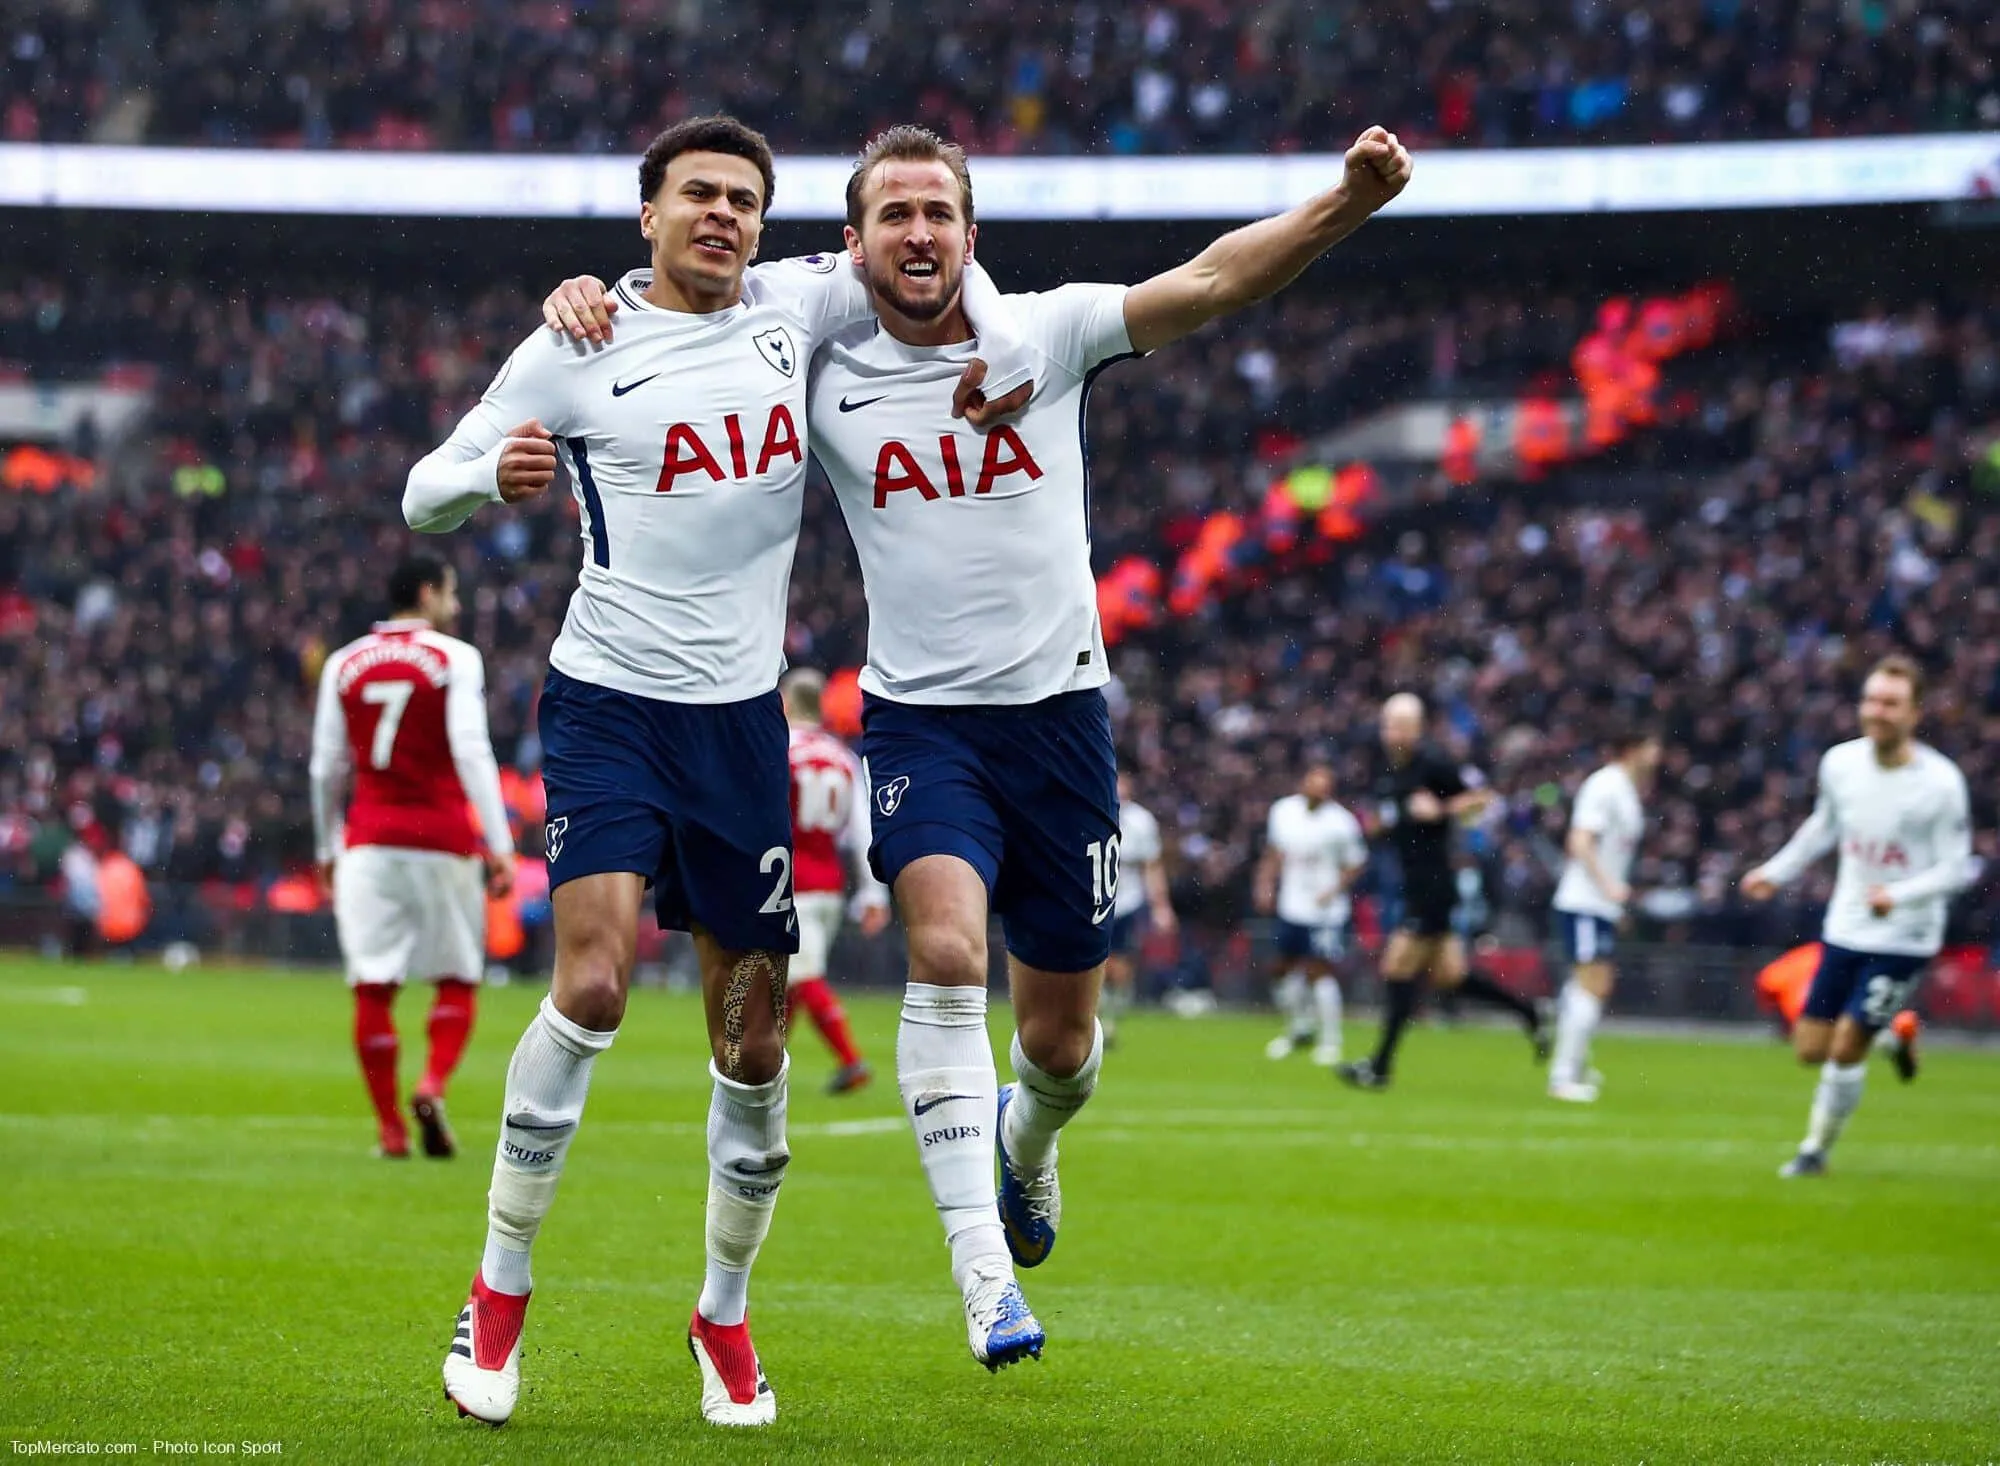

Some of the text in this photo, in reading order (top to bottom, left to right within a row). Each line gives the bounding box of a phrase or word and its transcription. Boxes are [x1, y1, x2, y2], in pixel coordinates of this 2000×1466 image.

[630, 279, 653, 289] NIK
[655, 404, 803, 493] AIA
[873, 424, 1044, 509] AIA
[361, 680, 416, 770] 7
[797, 765, 853, 834] 10
[1086, 833, 1120, 906] 10
[503, 1139, 556, 1164] SPURS
[923, 1126, 981, 1147] SPURS
[738, 1182, 781, 1198] SPU
